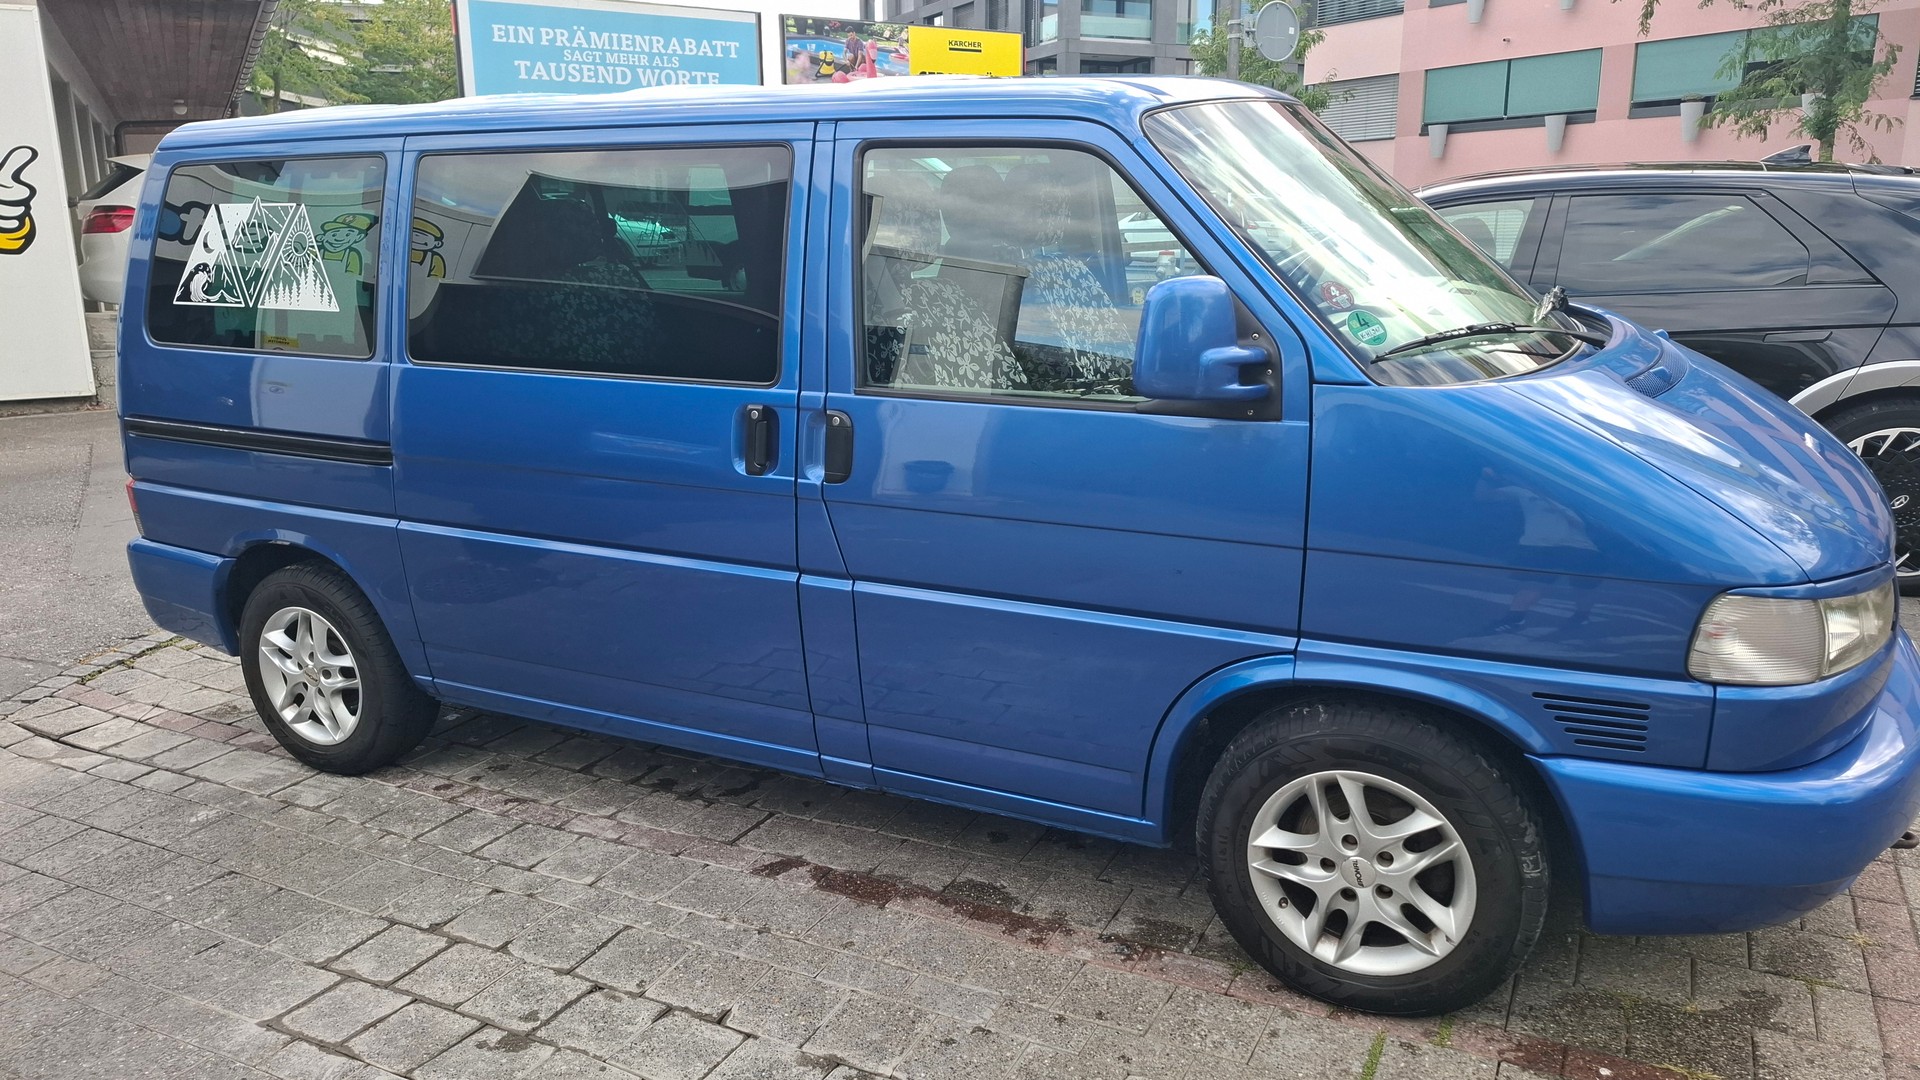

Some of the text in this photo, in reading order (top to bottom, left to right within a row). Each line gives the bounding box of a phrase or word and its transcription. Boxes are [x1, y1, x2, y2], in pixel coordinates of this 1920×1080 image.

[491, 24, 740, 58] EIN PRÄMIENRABATT
[563, 49, 680, 68] SAGT MEHR ALS
[513, 60, 720, 87] TAUSEND WORTE
[1355, 312, 1370, 328] 4
